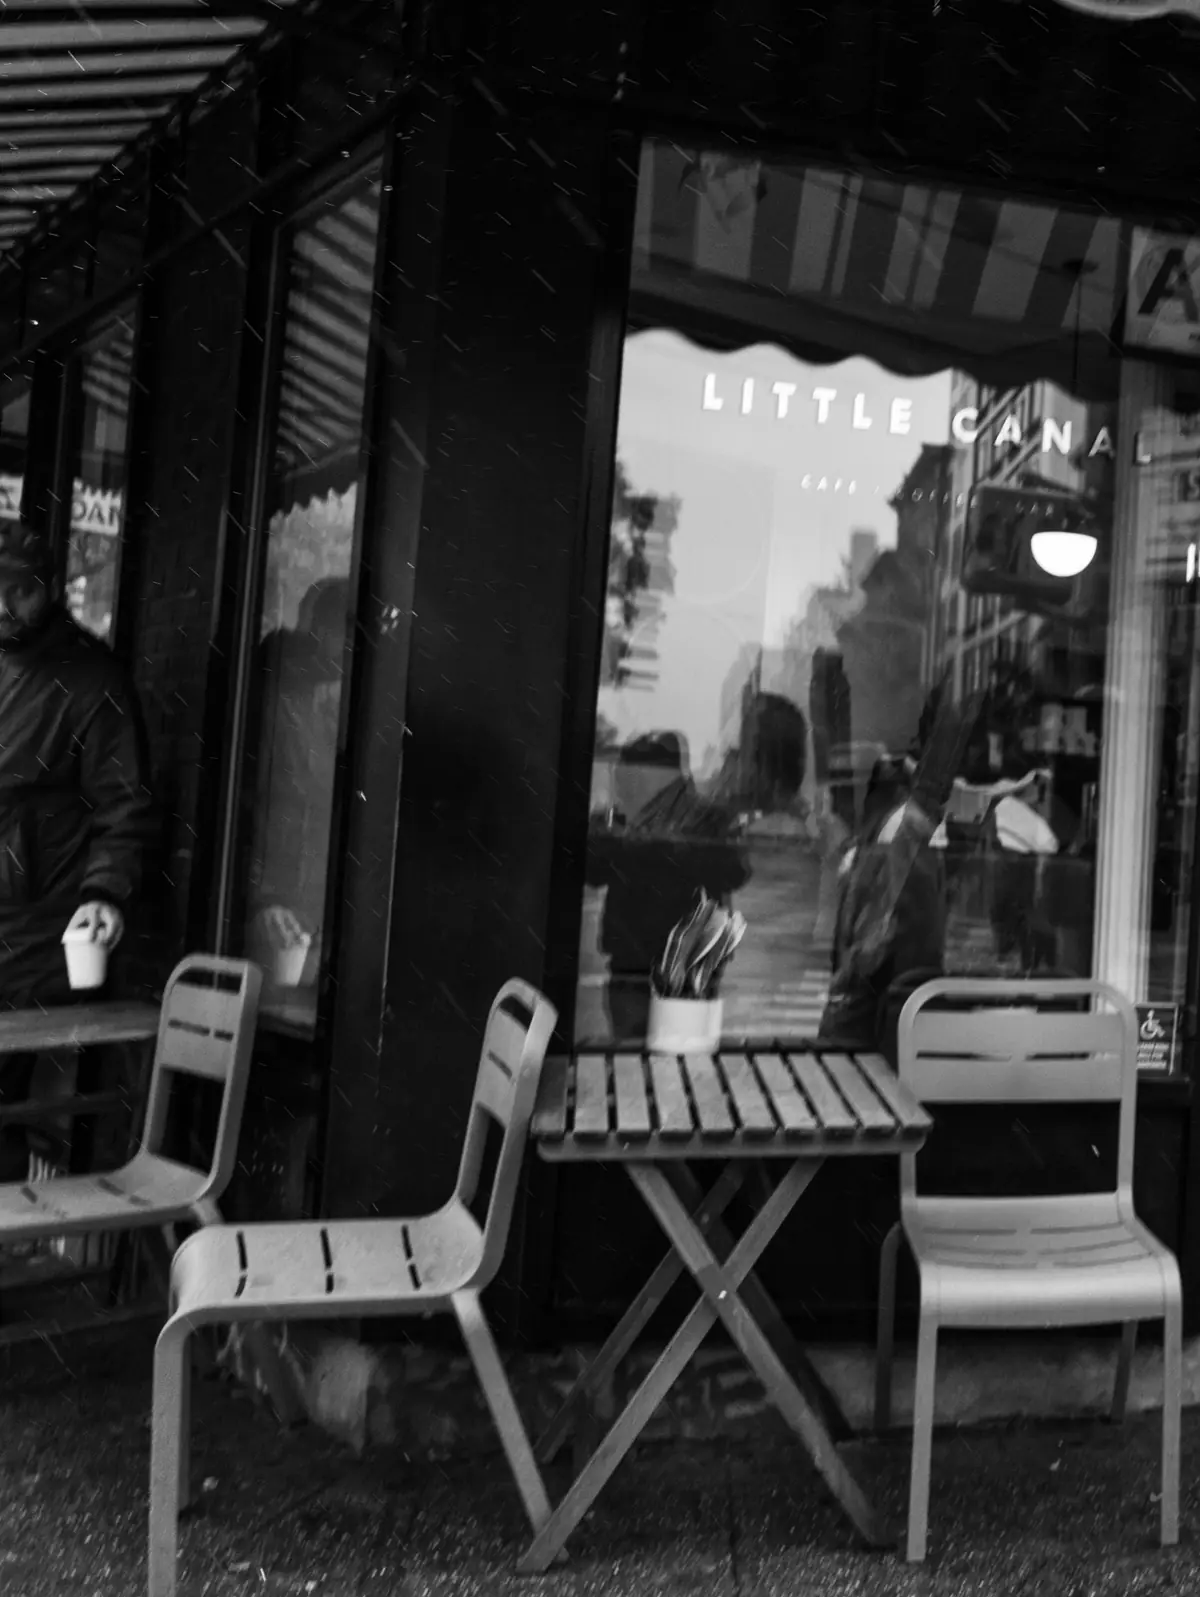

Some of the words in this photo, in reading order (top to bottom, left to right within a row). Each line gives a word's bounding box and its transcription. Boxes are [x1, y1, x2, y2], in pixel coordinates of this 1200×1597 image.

[1138, 247, 1200, 325] A
[702, 372, 913, 435] LITTLE
[952, 406, 1152, 465] CANAL
